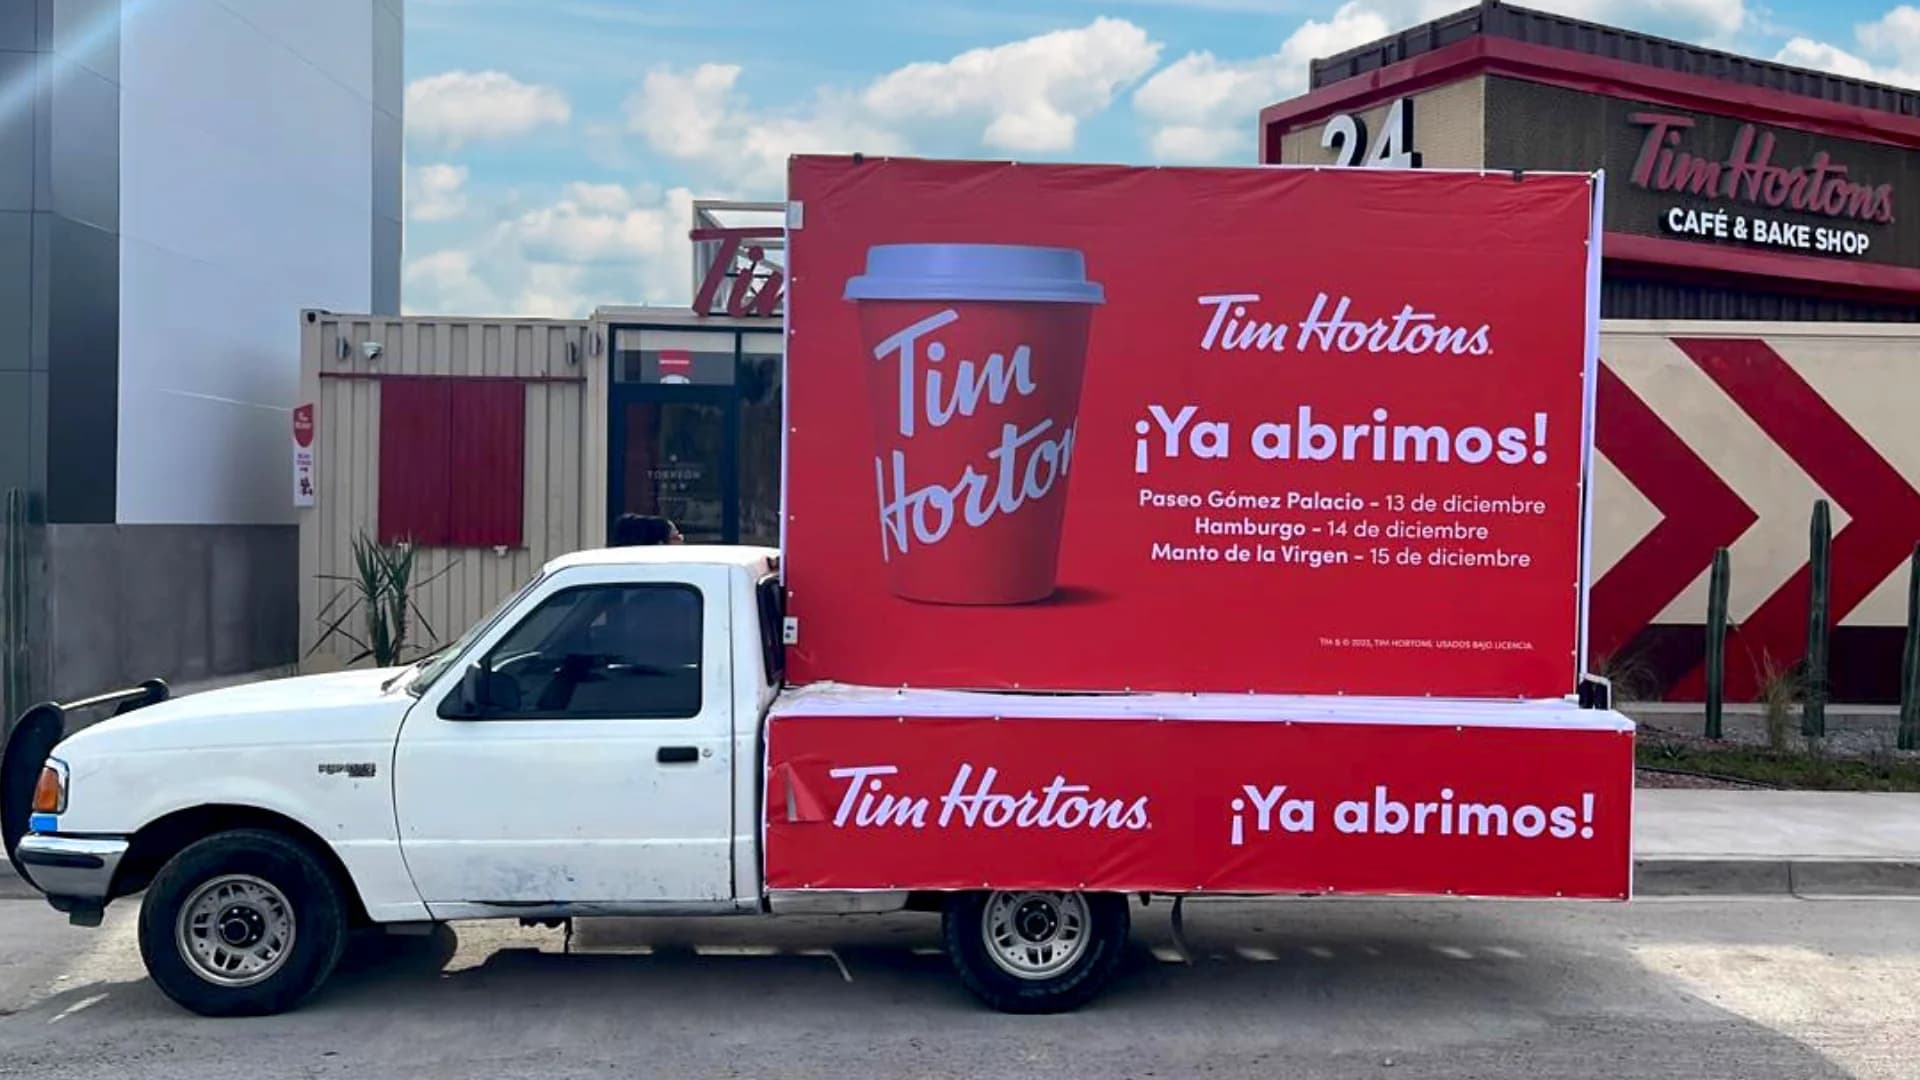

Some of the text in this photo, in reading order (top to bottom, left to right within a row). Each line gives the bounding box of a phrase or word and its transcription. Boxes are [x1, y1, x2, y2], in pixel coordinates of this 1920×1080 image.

[1629, 112, 1722, 199] Tim
[1668, 207, 1870, 255] CAFÉ & BAKE SHOP
[1198, 293, 1289, 351] Tim
[873, 309, 1037, 437] Tim
[1135, 405, 1548, 474] ¡Ya abrimos!
[1139, 489, 1202, 508] Paseo
[1208, 489, 1281, 509] Gómez
[1287, 491, 1364, 511] Palacio
[1386, 495, 1405, 512] 13
[1411, 493, 1437, 513] de
[1443, 495, 1546, 514] diciembre
[1195, 517, 1306, 541] Hamburgo
[1328, 520, 1348, 537] 14
[1354, 520, 1380, 538] de
[1386, 520, 1489, 540] diciembre
[1151, 543, 1219, 561] Manto
[1224, 544, 1251, 562] de
[1257, 544, 1276, 563] la
[1281, 545, 1348, 568] Virgen
[1370, 548, 1390, 565] 15
[1396, 547, 1422, 565] de
[1428, 548, 1531, 567] diciembre
[1435, 640, 1470, 649] USADOS
[829, 765, 926, 827] Tim
[1231, 785, 1595, 845] ¡Ya abrimos!
